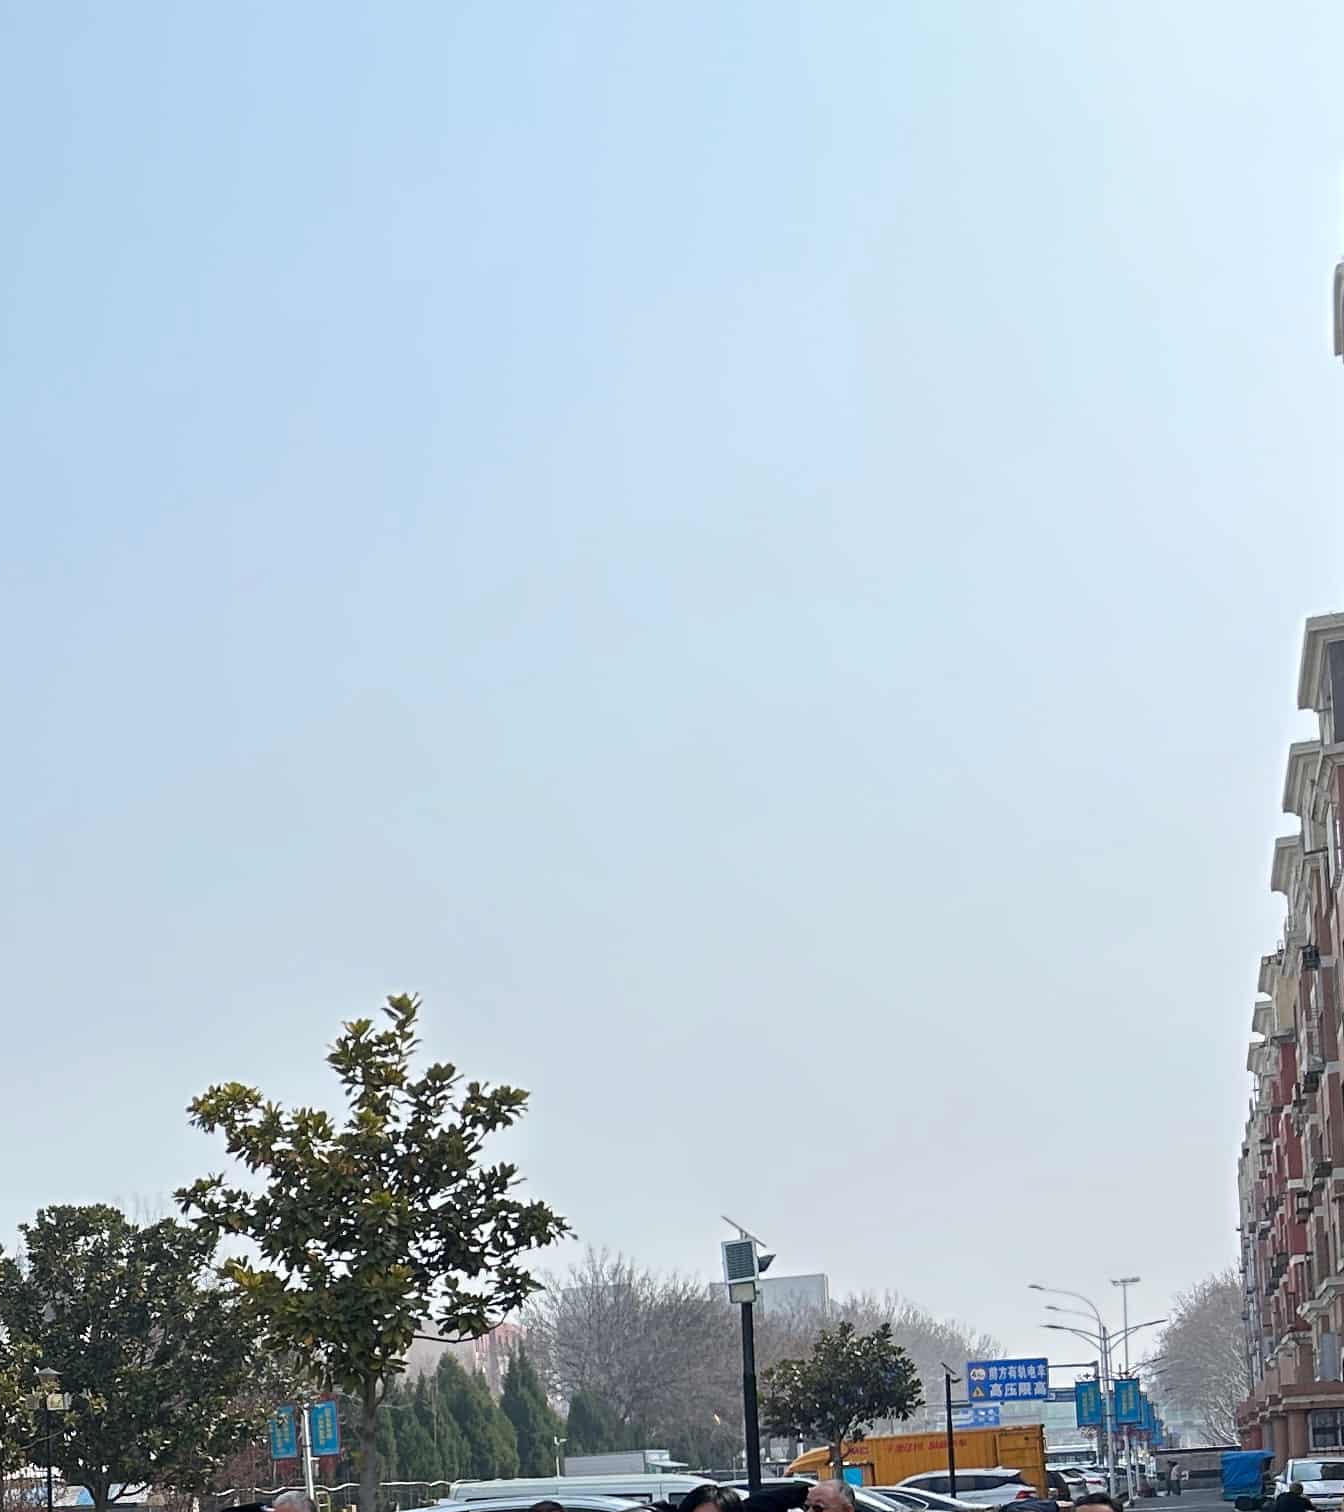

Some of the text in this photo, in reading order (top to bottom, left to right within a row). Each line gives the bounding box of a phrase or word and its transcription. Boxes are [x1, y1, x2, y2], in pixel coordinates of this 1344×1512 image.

[989, 1365, 1047, 1381] 前方有轨电车
[990, 1382, 1047, 1398] 高压限高
